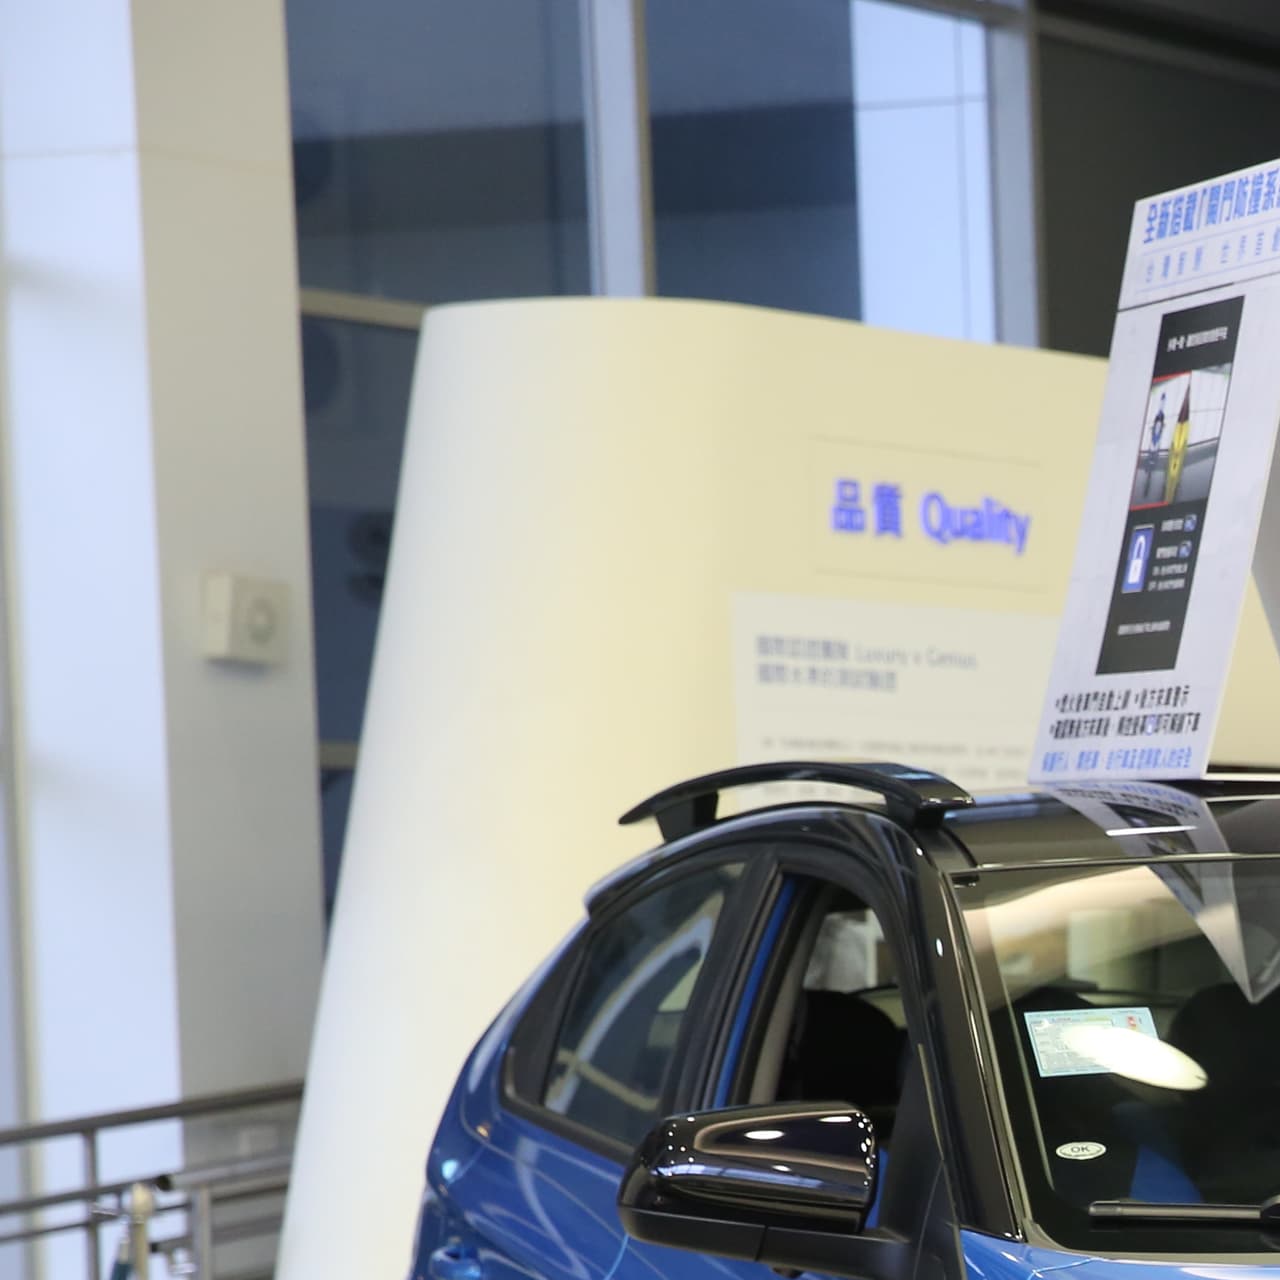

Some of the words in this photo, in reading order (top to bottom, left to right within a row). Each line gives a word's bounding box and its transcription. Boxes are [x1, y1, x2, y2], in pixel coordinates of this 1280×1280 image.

[832, 478, 902, 539] 品質
[920, 491, 1029, 556] Quality
[1071, 1145, 1090, 1153] OK
